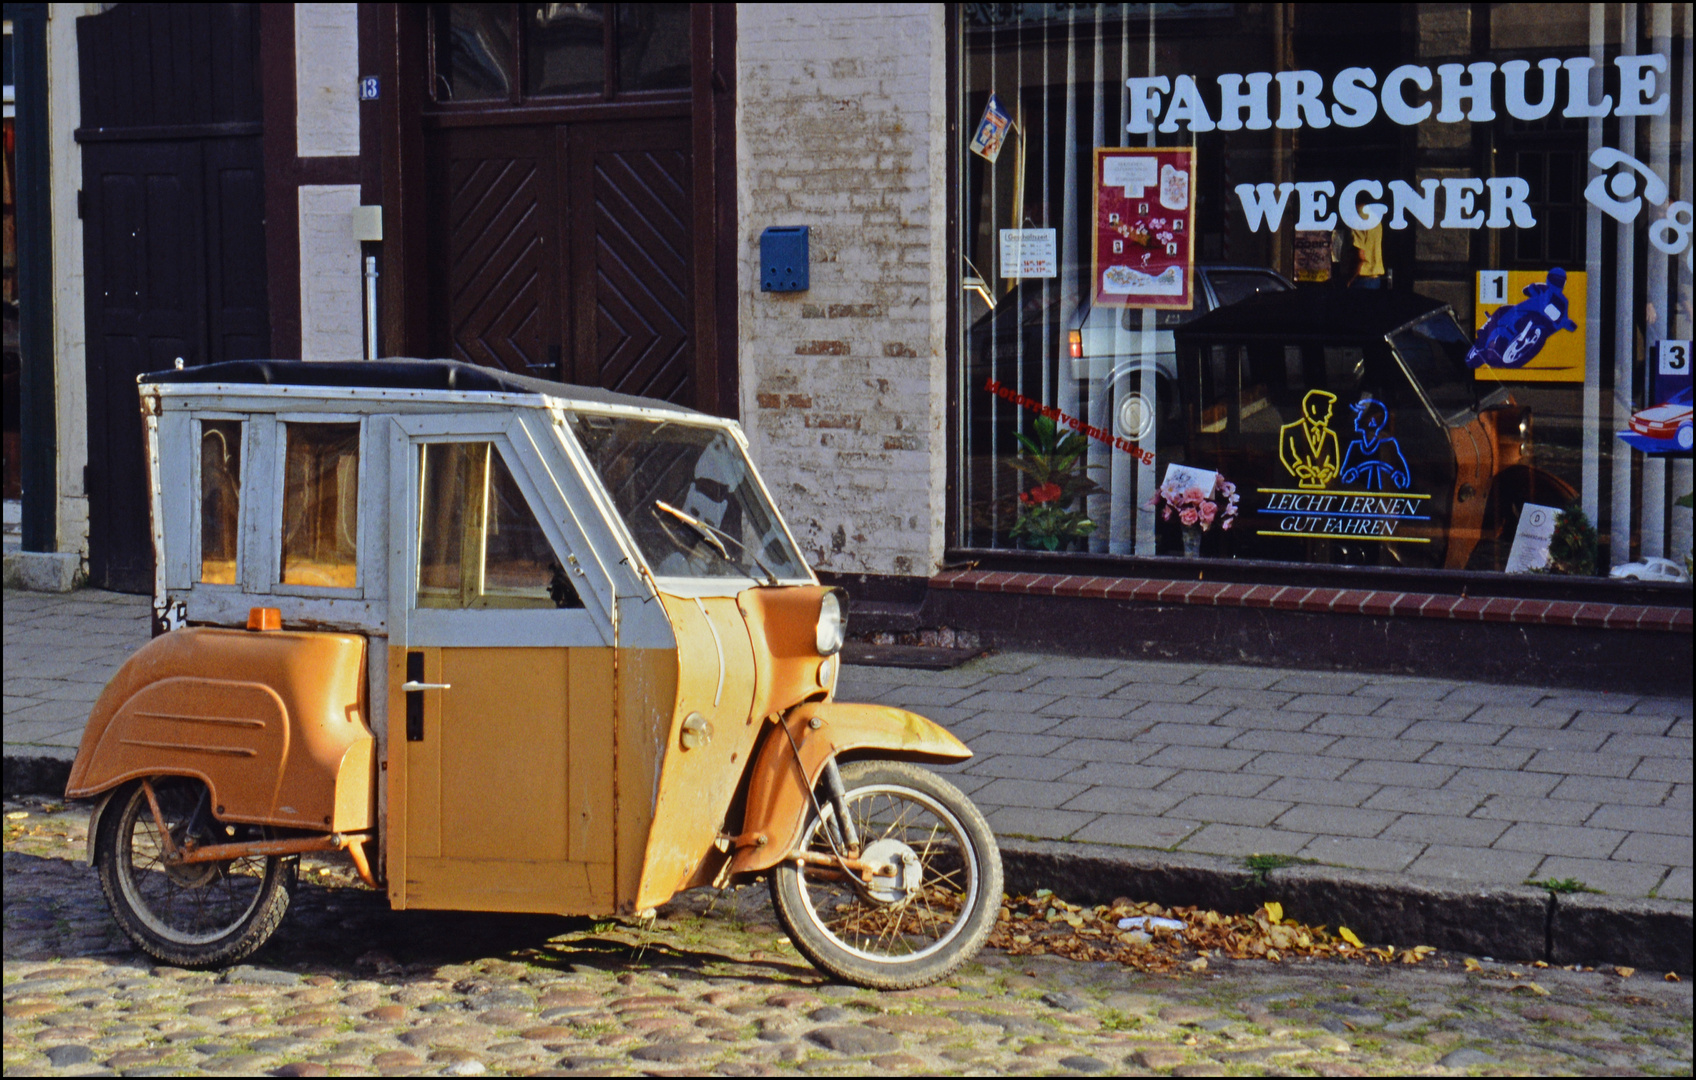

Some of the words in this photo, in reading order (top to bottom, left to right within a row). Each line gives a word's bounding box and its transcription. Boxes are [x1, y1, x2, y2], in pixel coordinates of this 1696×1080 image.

[362, 78, 378, 98] 13
[1126, 53, 1669, 134] FAHRSCHULE
[1235, 177, 1537, 233] WEGNER
[1648, 200, 1694, 274] 8
[1492, 276, 1503, 298] 1
[1669, 346, 1685, 369] 3
[984, 377, 1155, 465] Motorradvermietung
[1266, 493, 1337, 512] LEICHT
[1339, 496, 1421, 515] LERNEN
[1280, 516, 1321, 532] GUT
[1323, 517, 1399, 536] FAHREN
